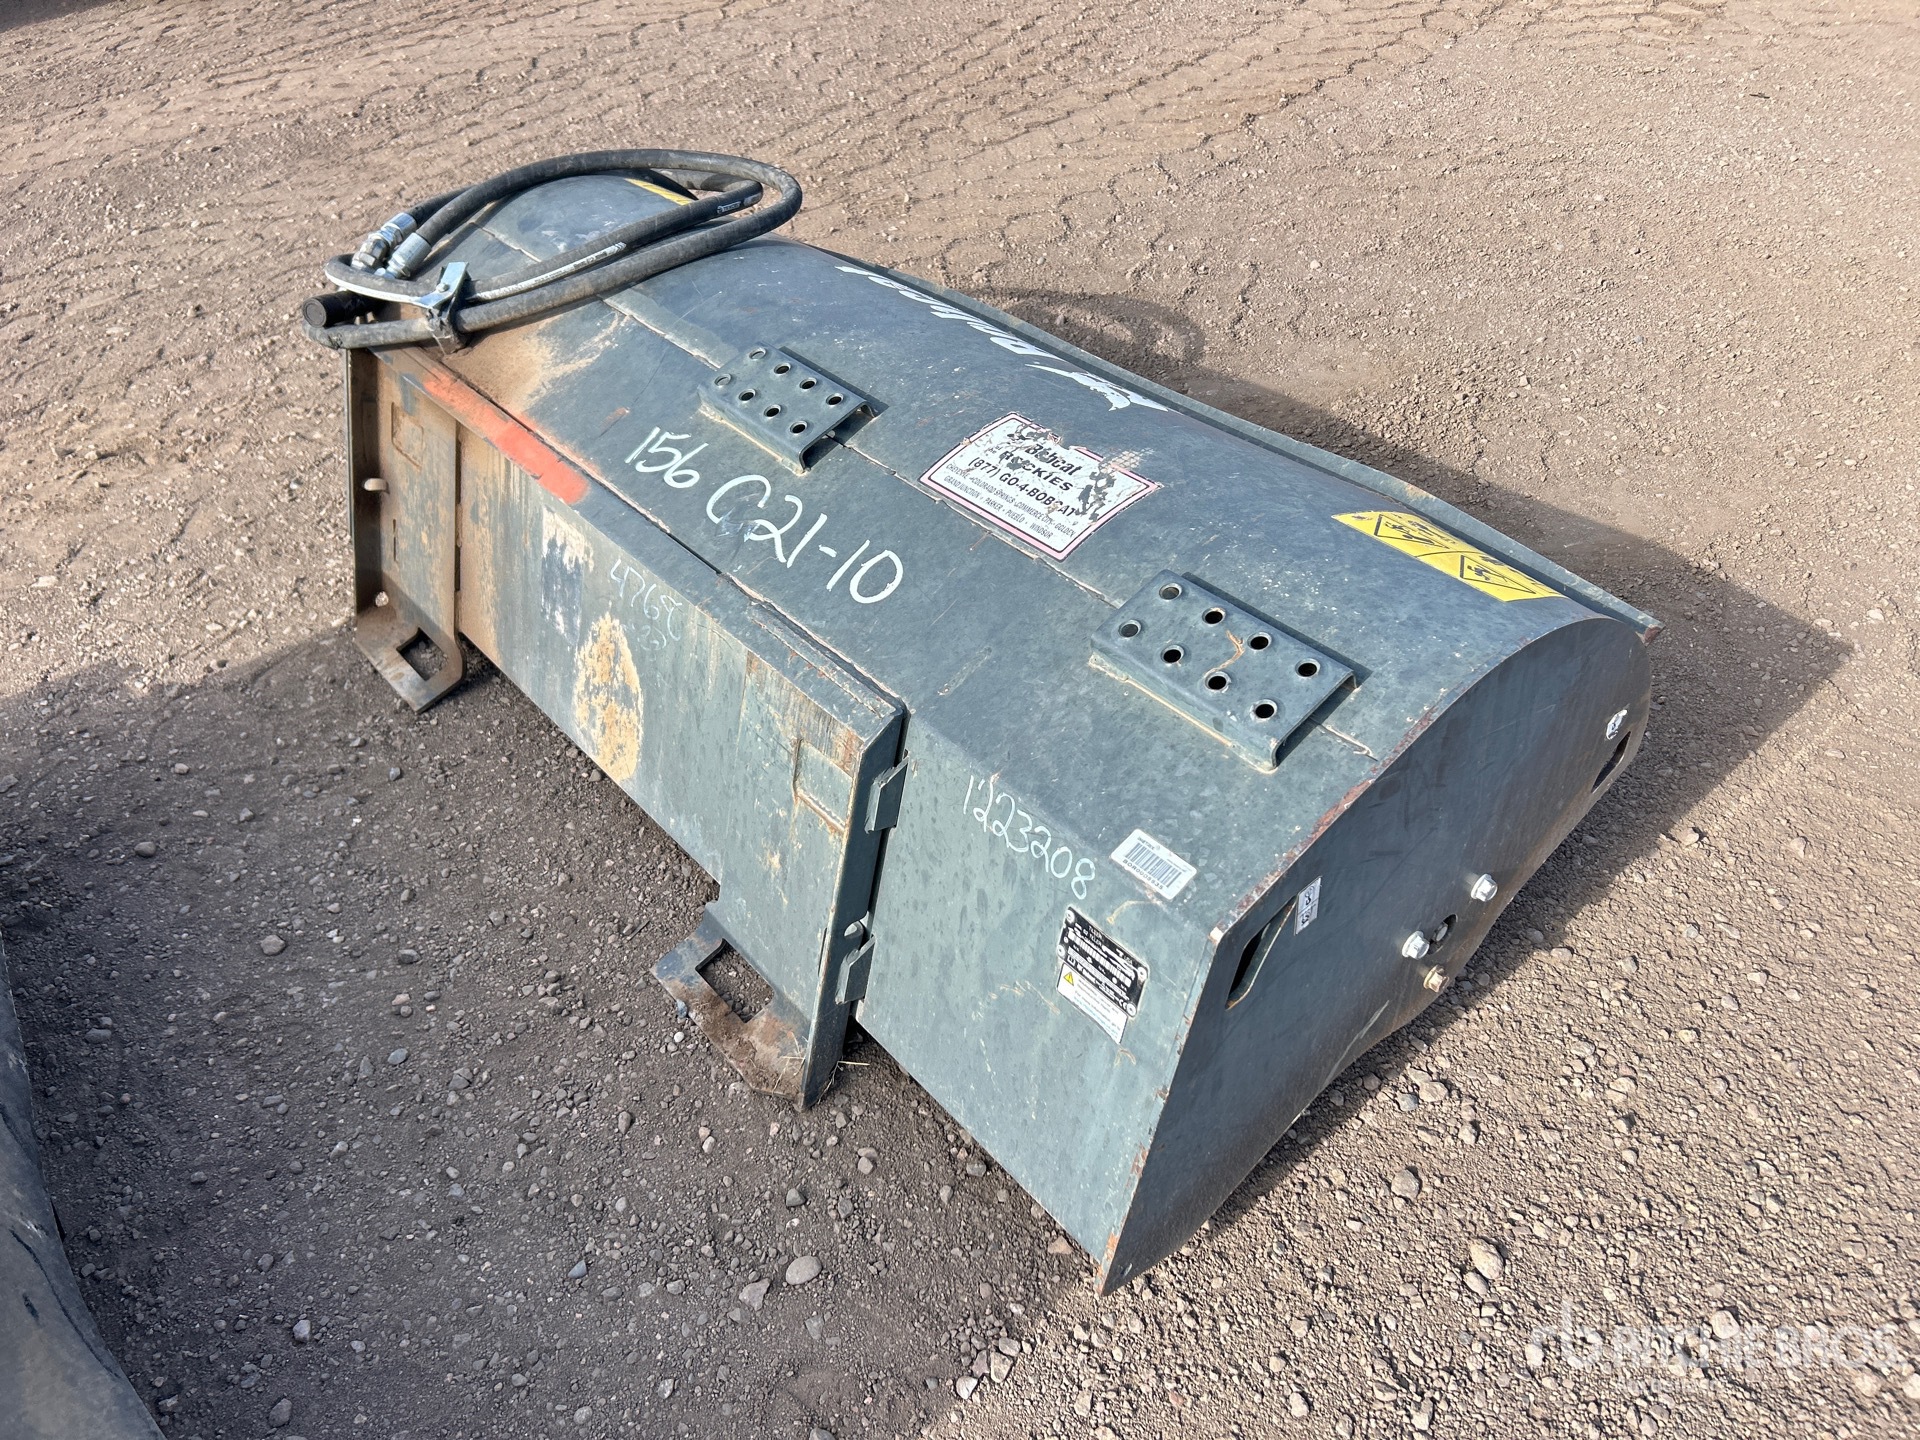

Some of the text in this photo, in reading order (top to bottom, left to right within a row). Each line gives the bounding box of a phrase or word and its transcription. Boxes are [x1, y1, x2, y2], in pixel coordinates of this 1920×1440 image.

[625, 426, 709, 488] 156
[968, 457, 1001, 478] (877)
[963, 775, 1096, 900] 1223208
